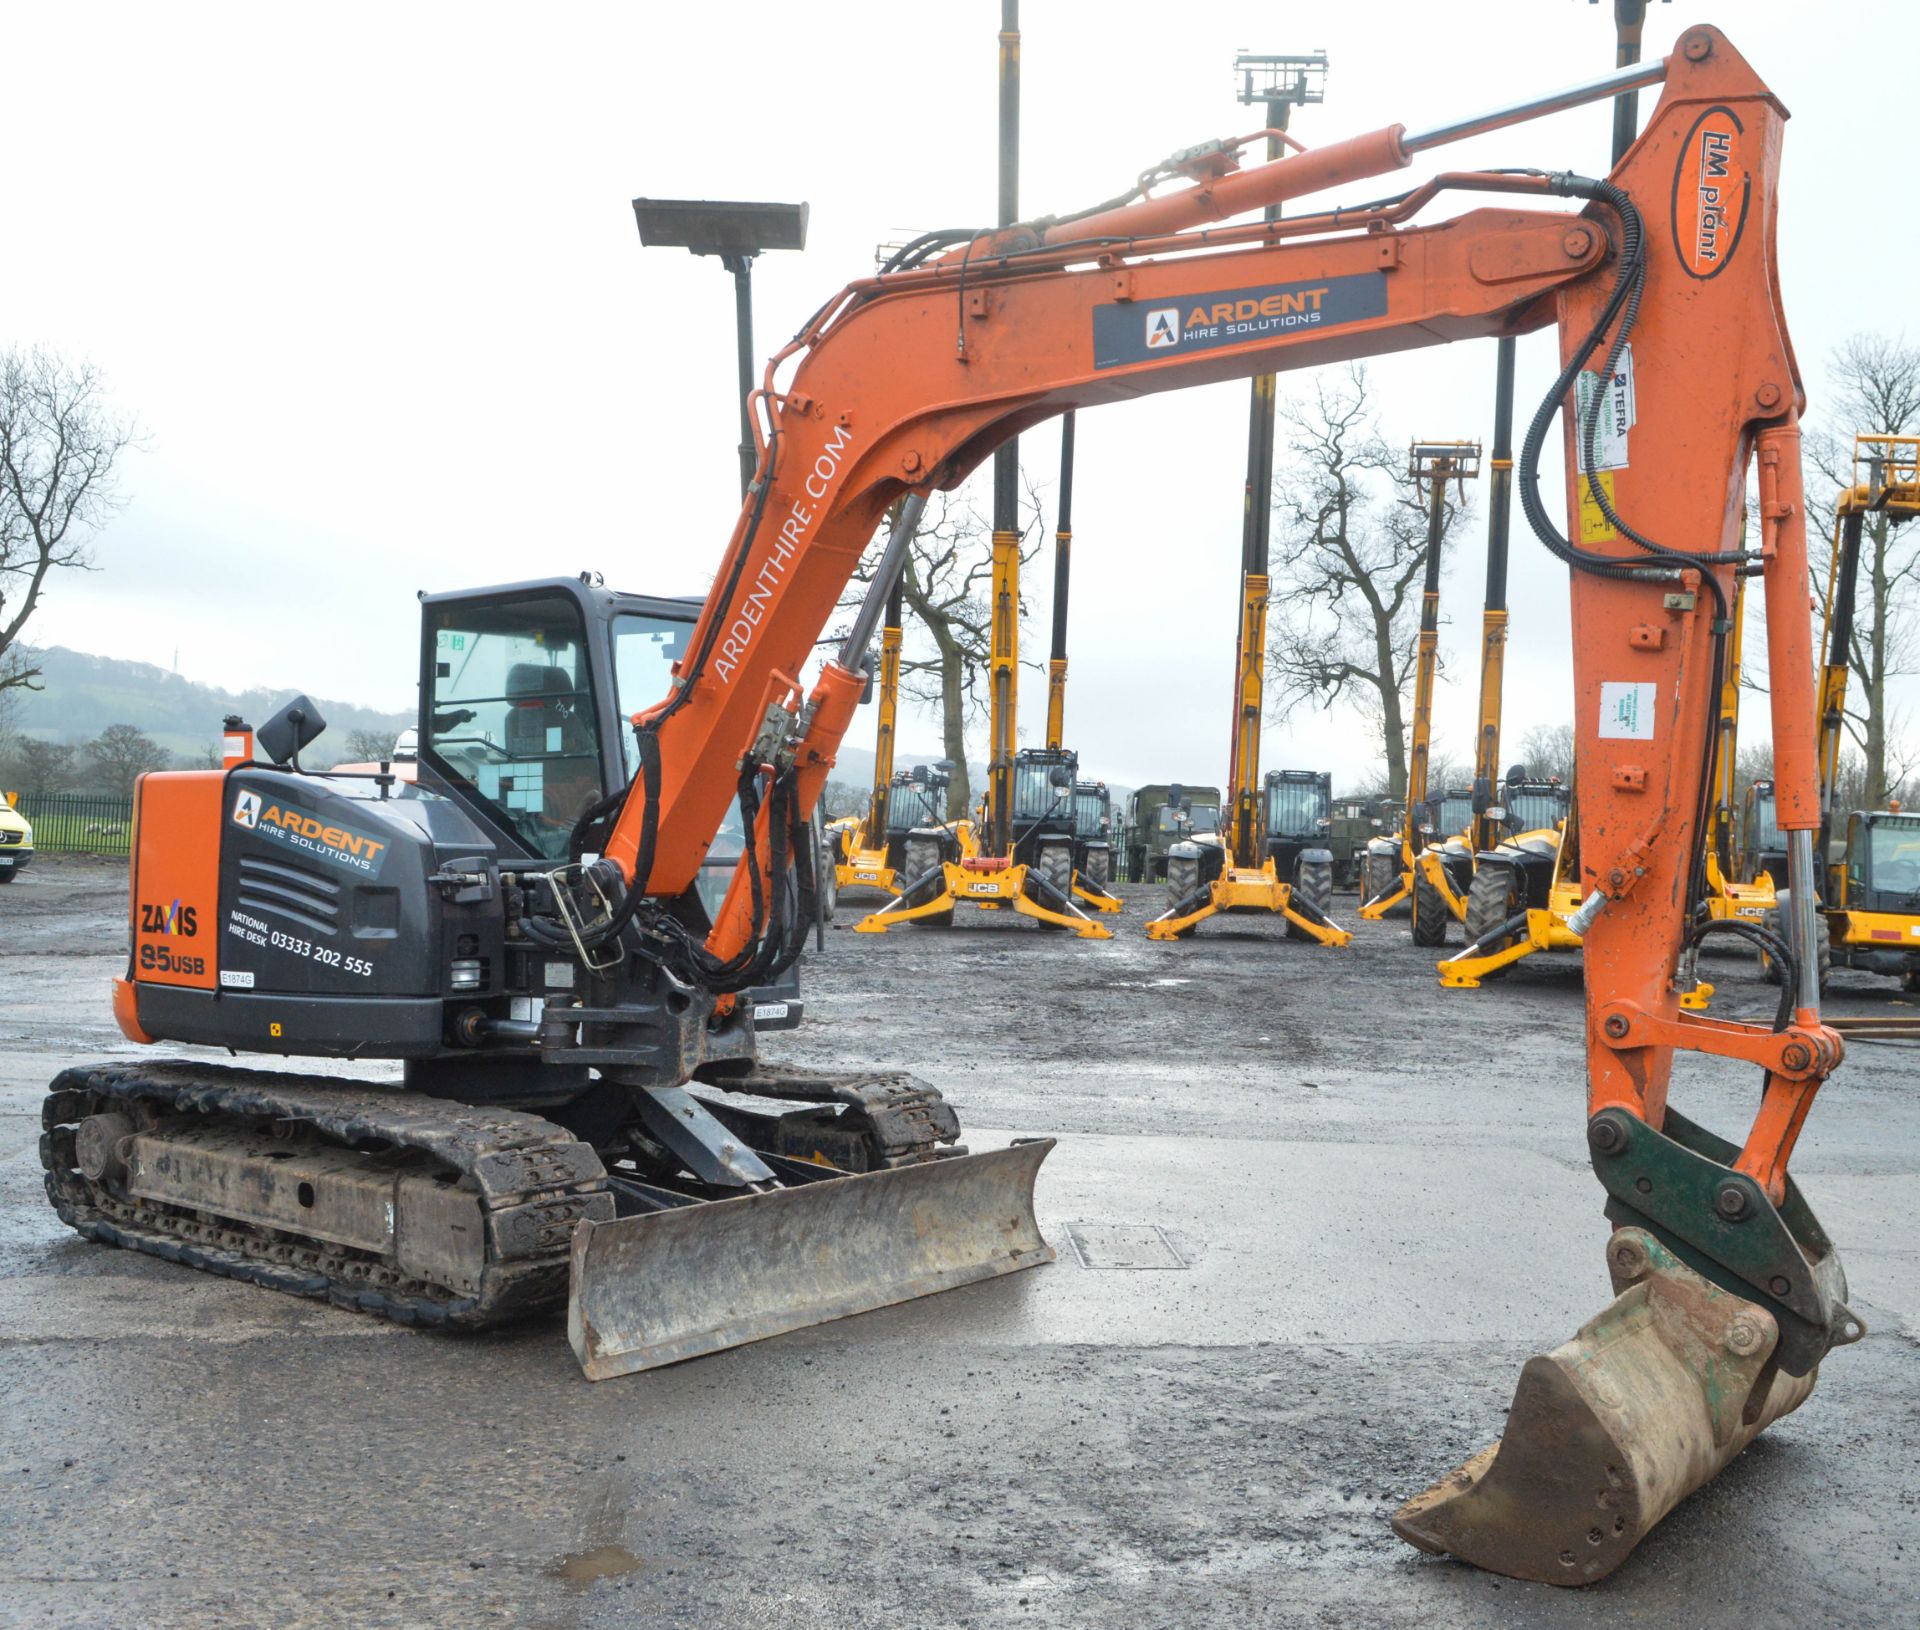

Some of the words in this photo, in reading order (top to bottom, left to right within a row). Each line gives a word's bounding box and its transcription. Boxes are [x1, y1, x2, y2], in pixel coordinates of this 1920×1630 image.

[1702, 130, 1731, 176] HM
[1699, 186, 1727, 261] plant
[1183, 327, 1219, 341] HIRE
[1226, 312, 1322, 335] SOLUTIONS
[1185, 287, 1329, 329] ARDENT
[1614, 389, 1627, 438] TEFRA
[714, 425, 852, 684] ARDENTHIRE.COM
[258, 821, 286, 839] HIRE
[290, 834, 371, 870] SOLUTIONS
[261, 805, 384, 860] ARDENT
[854, 872, 877, 880] JCB
[968, 883, 999, 893] JCB
[142, 899, 197, 937] ZAXIS
[229, 923, 246, 938] HIRE
[246, 931, 267, 947] DESK
[231, 910, 269, 934] NATIONAL
[271, 931, 312, 956] 03333
[313, 946, 341, 967] 202
[344, 957, 373, 976] 555
[222, 973, 252, 985] E1874G
[756, 1007, 786, 1017] E1874G
